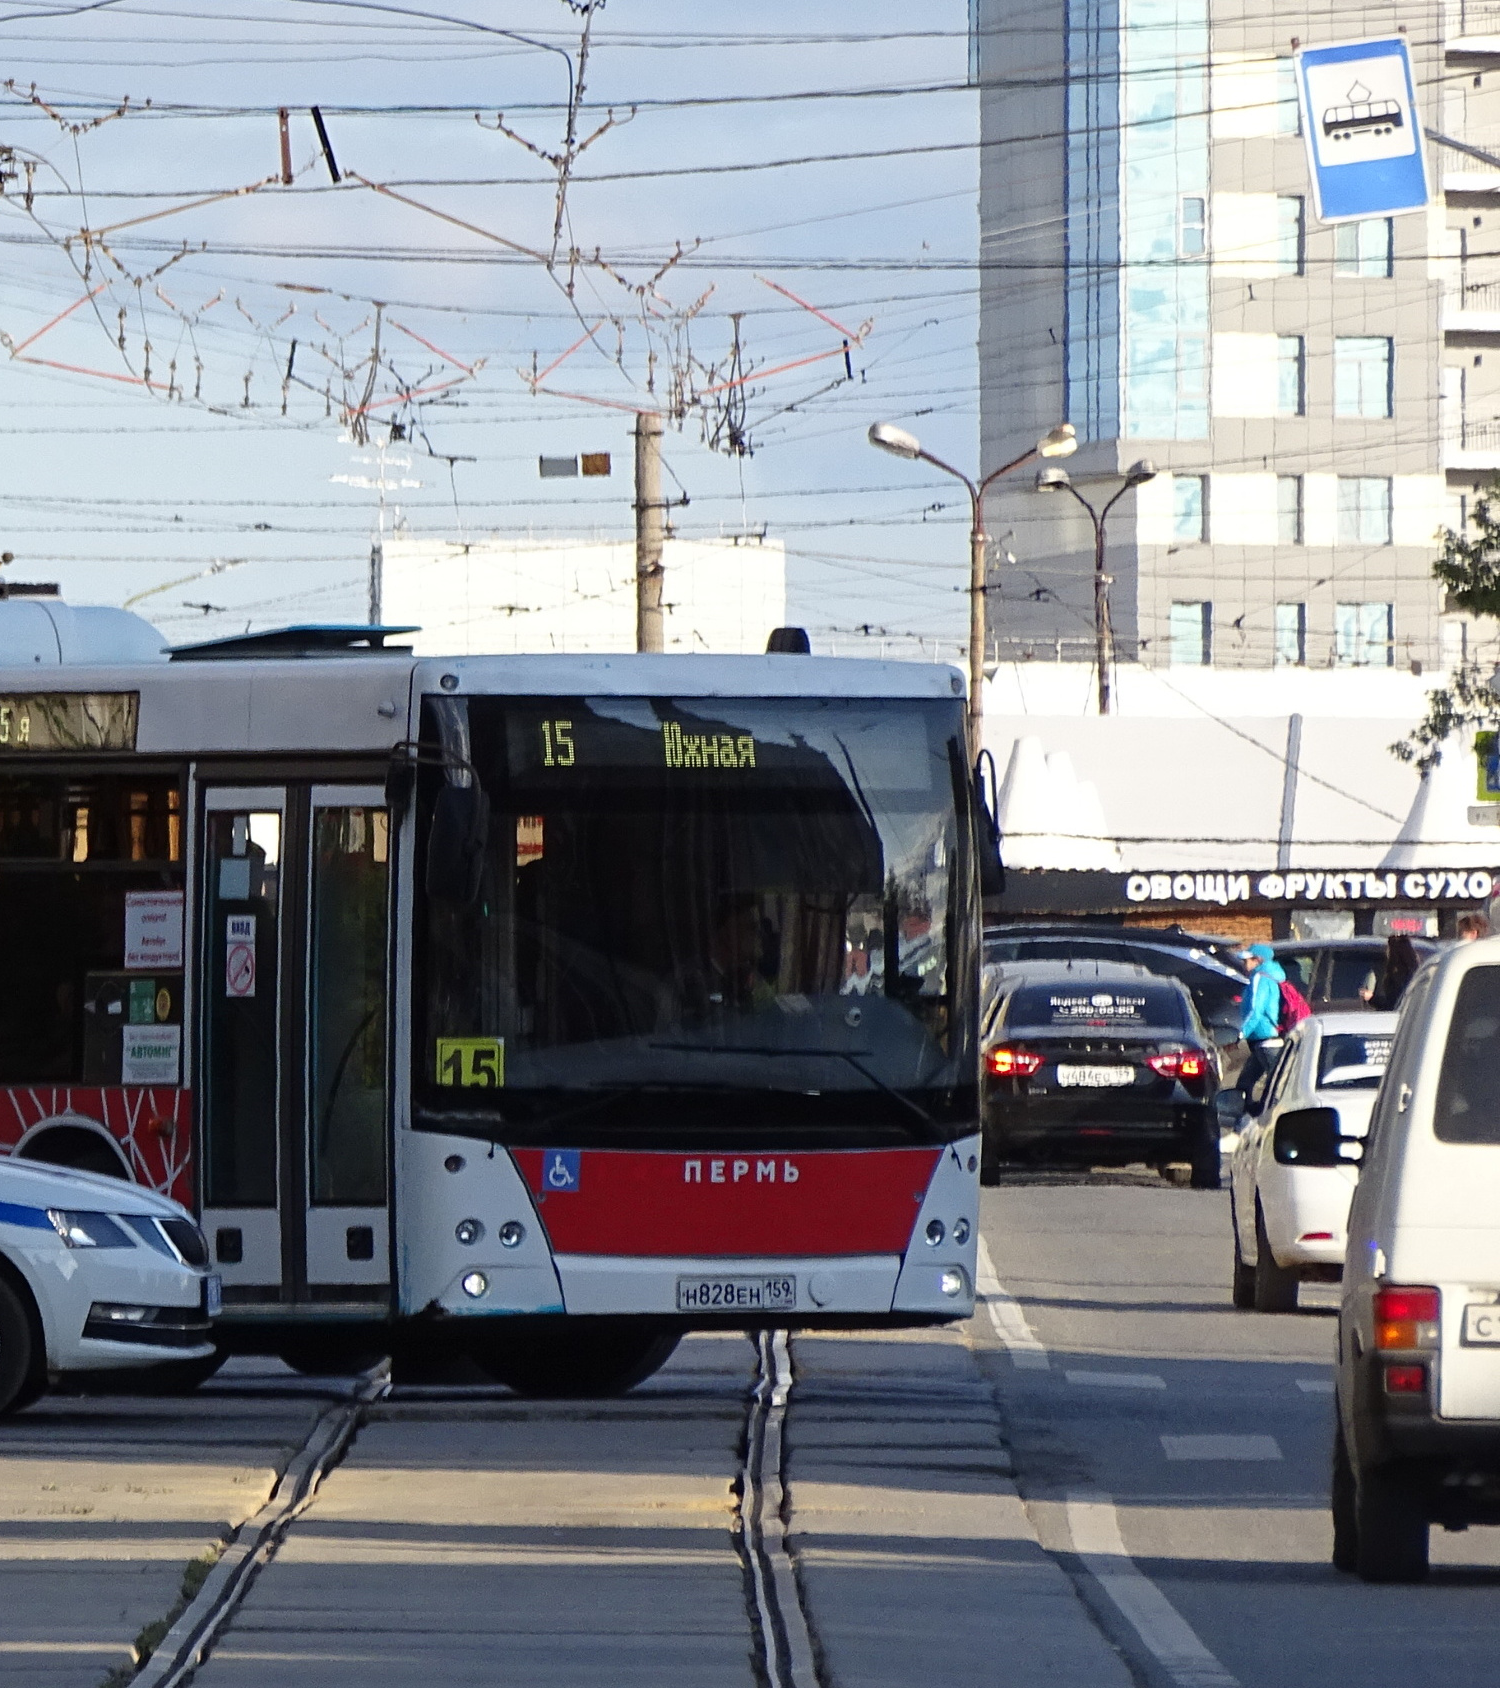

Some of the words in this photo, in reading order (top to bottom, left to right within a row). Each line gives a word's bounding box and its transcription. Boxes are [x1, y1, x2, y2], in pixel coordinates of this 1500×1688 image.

[542, 720, 575, 766] 15
[663, 721, 756, 767] Южная
[1126, 873, 1250, 906] ОВОЩИ
[1258, 872, 1396, 900] ФРУКТЫ
[443, 1048, 497, 1087] 15
[684, 1159, 800, 1183] ПЕРМЬ
[685, 1283, 761, 1305] Н828ЕН
[765, 1278, 791, 1298] 159
